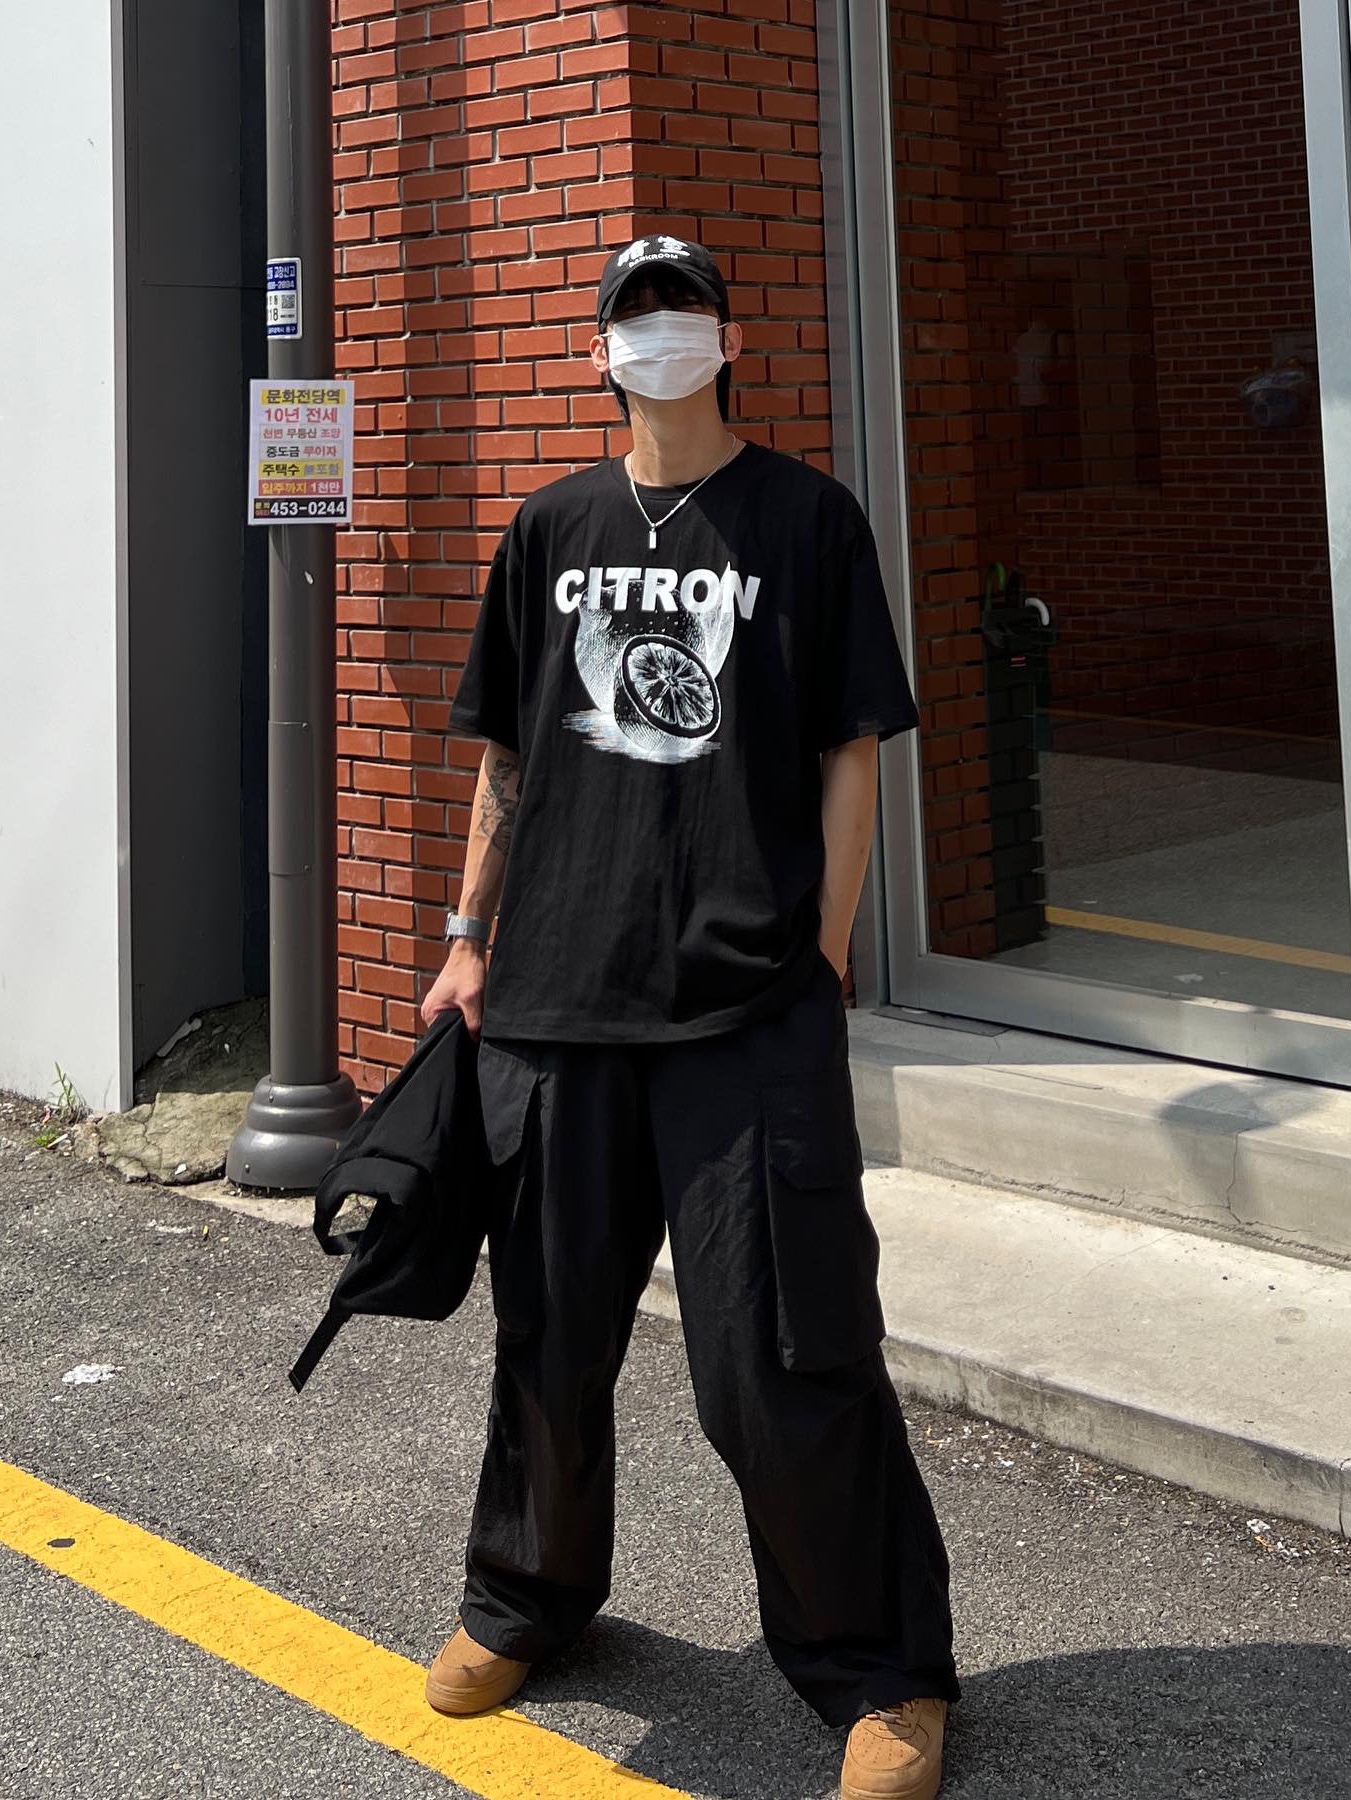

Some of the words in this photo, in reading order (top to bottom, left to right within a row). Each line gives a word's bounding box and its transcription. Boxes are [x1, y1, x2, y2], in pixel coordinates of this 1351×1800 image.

[628, 253, 678, 268] DARKROOM
[267, 388, 341, 404] 문화전당역
[265, 407, 300, 423] 10년
[306, 407, 338, 423] 전세
[287, 428, 317, 439] 무등산
[266, 446, 300, 458] 중도금
[303, 445, 337, 457] 무이자
[263, 463, 300, 476] 주택수
[262, 481, 307, 494] 입주까지
[310, 481, 341, 494] 1천만
[270, 501, 345, 516] 453-0244
[555, 566, 762, 621] CITRON
